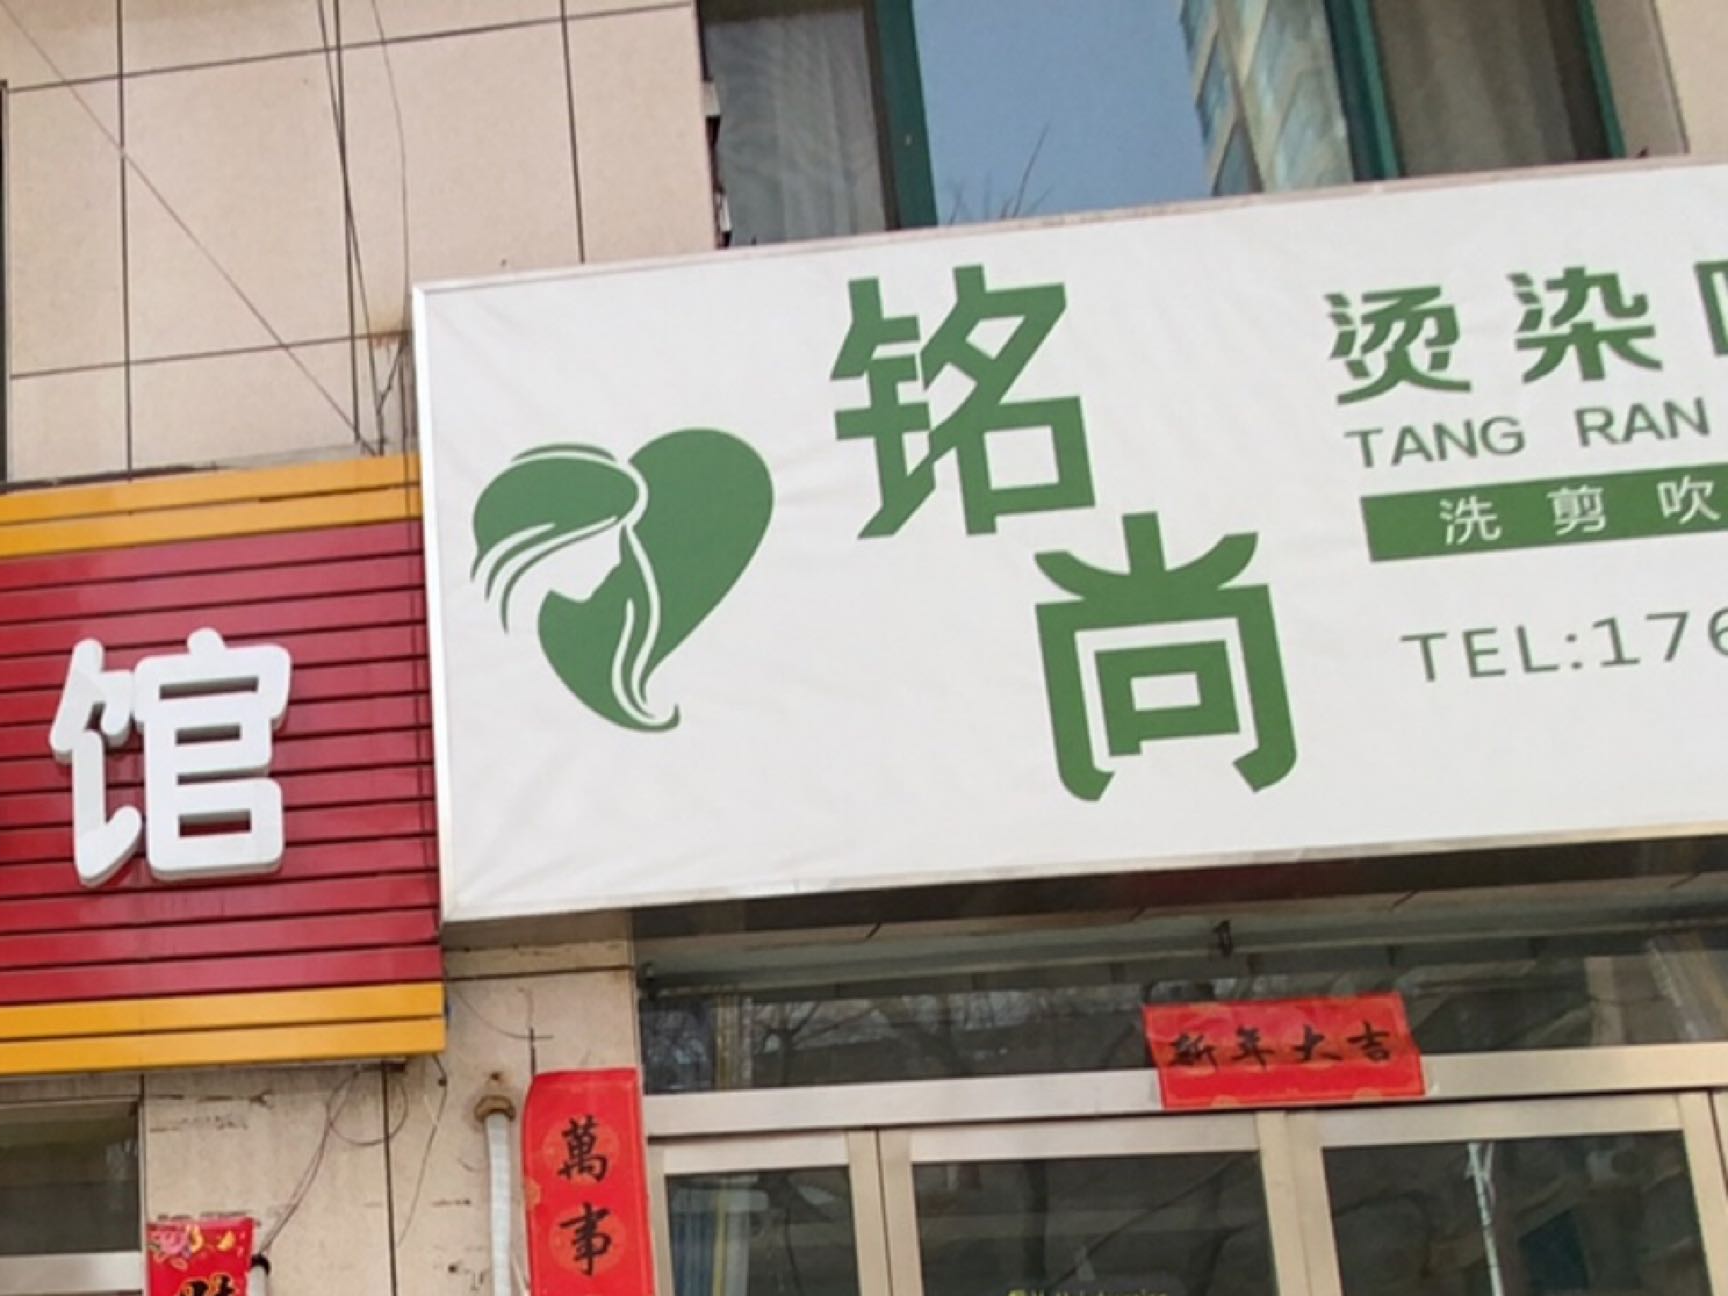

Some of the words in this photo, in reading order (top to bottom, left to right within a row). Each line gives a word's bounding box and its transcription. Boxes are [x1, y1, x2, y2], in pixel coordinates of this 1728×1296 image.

[1324, 261, 1728, 405] 烫染
[1344, 416, 1526, 468] TANG
[1575, 397, 1710, 447] RAN
[829, 264, 1298, 802] 铭尚
[1440, 475, 1722, 546] 洗剪吹
